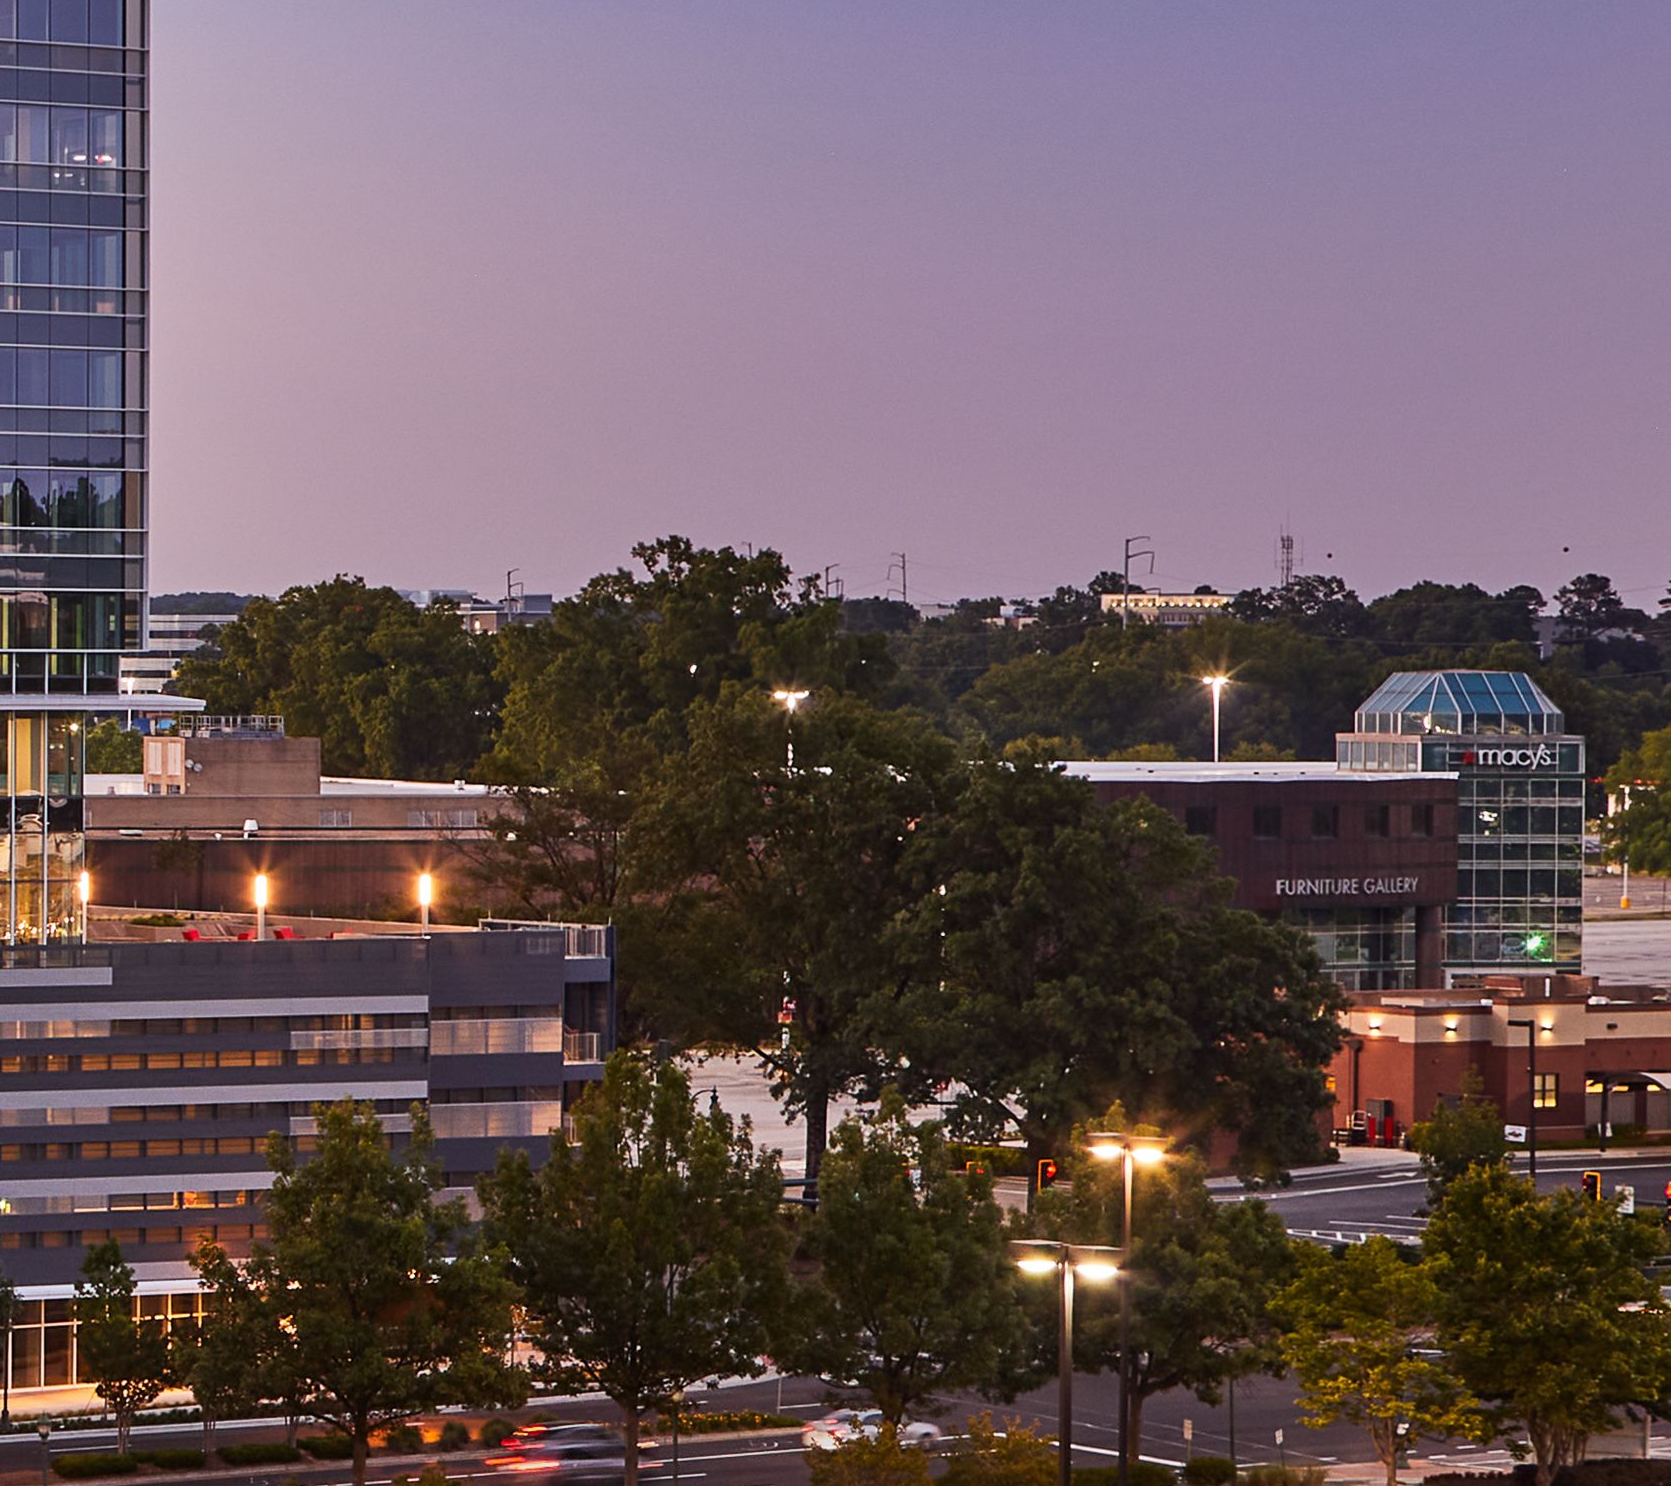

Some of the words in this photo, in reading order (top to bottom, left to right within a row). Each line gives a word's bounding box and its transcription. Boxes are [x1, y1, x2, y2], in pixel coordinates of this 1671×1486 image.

[1477, 744, 1552, 770] macy's
[1276, 877, 1360, 897] FURNITURE
[1363, 876, 1420, 895] GALLERY
